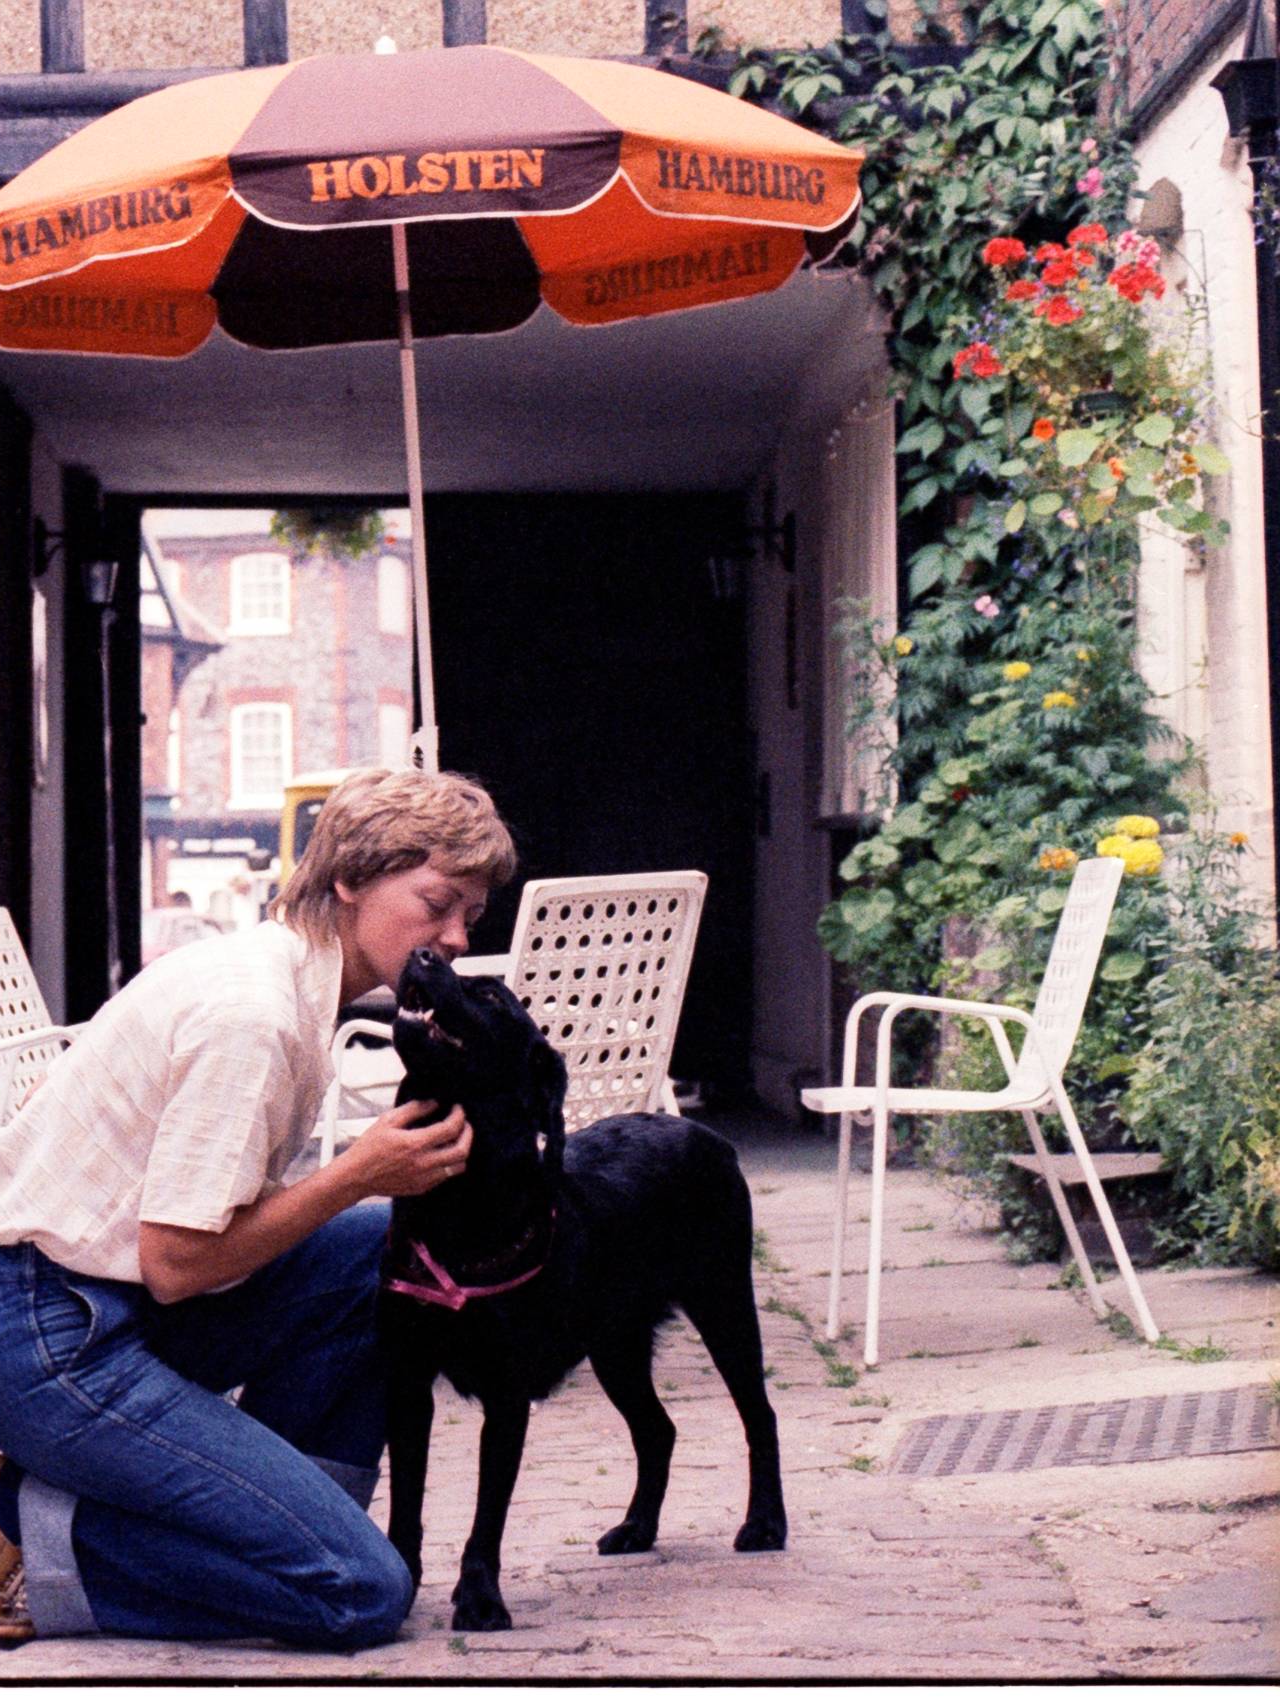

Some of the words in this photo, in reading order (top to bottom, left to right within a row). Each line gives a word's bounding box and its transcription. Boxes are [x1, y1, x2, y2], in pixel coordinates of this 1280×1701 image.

[307, 148, 545, 202] HOLSTEN
[656, 147, 826, 205] HAMBURG
[0, 181, 192, 265] HAMBURG
